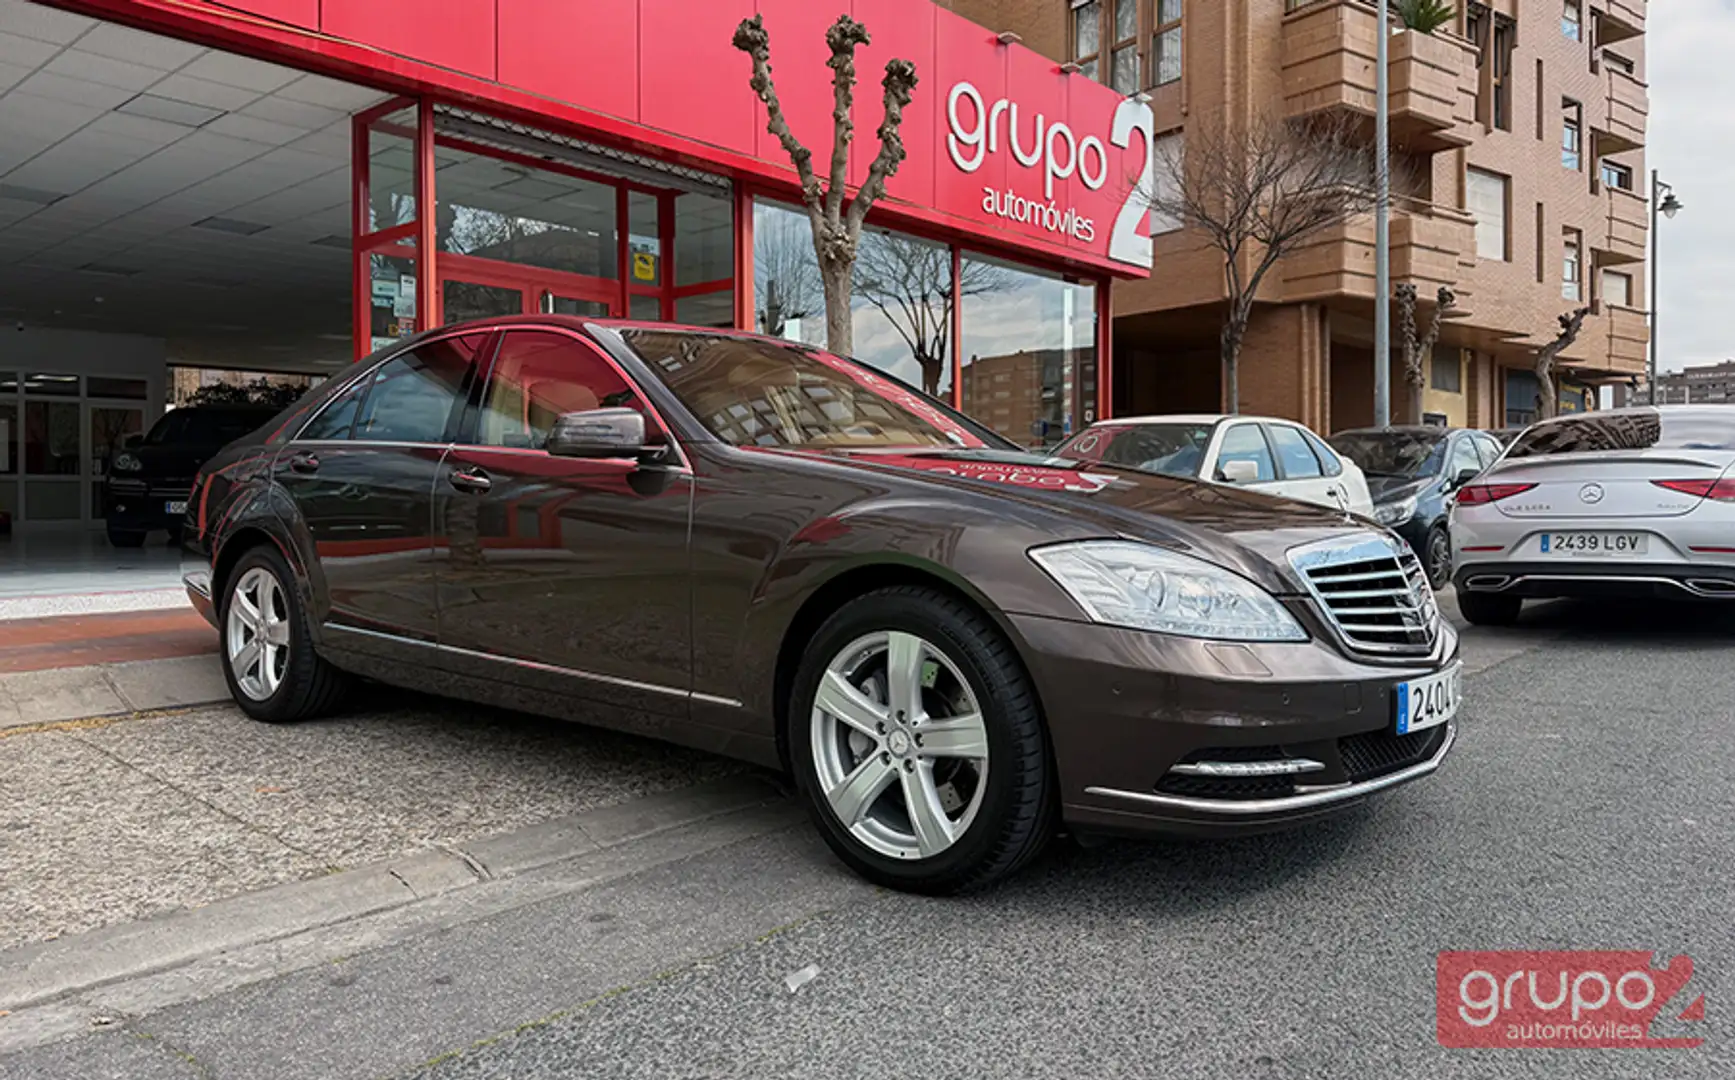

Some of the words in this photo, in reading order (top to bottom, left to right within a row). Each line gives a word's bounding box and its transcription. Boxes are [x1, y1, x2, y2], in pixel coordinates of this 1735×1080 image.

[948, 81, 1108, 199] grupo
[1108, 96, 1154, 269] 2
[982, 187, 1094, 241] automóviles
[1554, 534, 1598, 550] 2439
[1604, 535, 1638, 550] LGV
